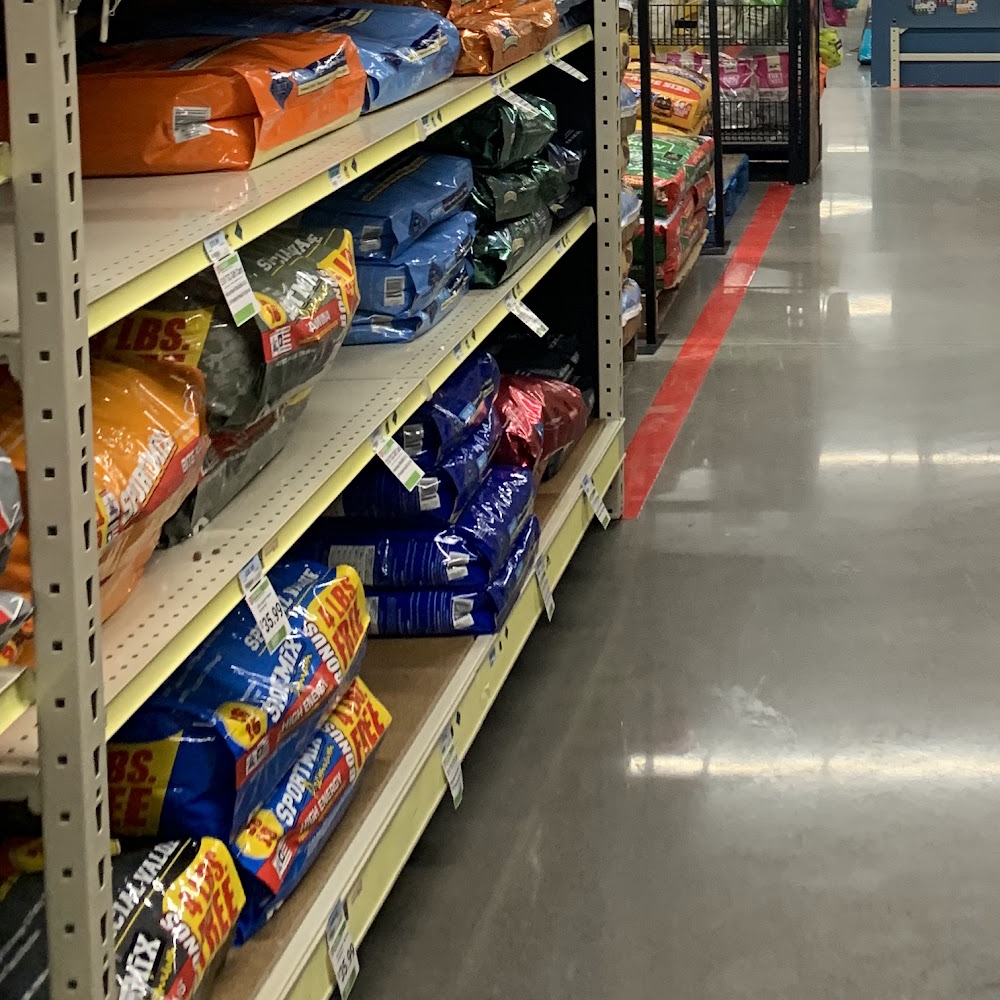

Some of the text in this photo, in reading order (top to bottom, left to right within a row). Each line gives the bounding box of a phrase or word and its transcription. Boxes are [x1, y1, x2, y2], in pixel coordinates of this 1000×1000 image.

[117, 316, 191, 351] LBS.
[317, 604, 335, 629] 4
[281, 709, 303, 732] HIGH
[107, 748, 157, 784] BS.
[108, 787, 153, 828] EE
[300, 772, 343, 832] HIGH ENERGY
